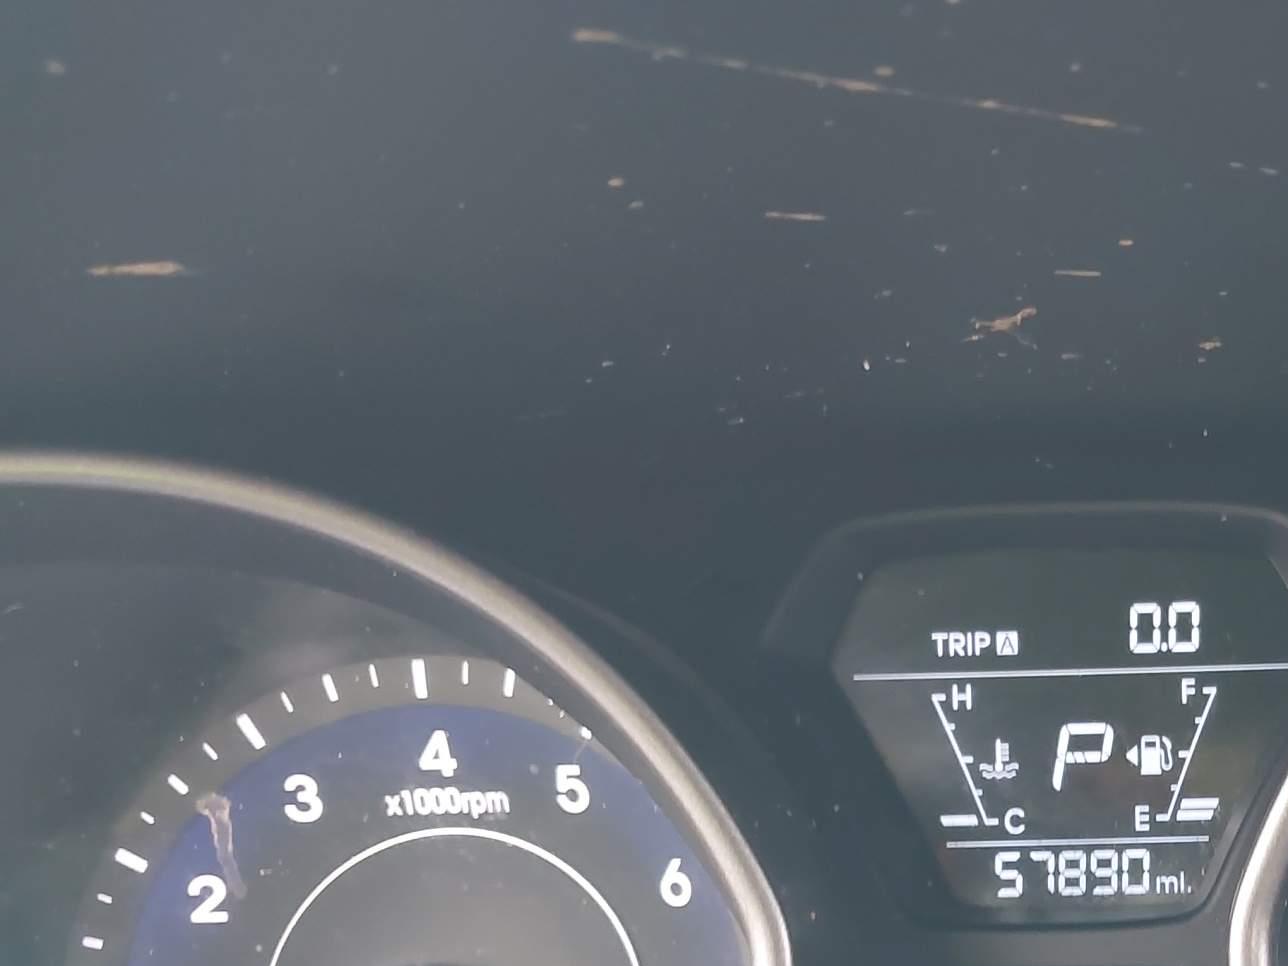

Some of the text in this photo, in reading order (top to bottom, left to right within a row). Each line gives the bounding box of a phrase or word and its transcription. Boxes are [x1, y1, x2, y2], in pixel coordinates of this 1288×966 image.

[931, 631, 991, 658] TRIP
[1129, 601, 1201, 654] 0.0
[951, 683, 972, 711] H
[1181, 677, 1196, 705] F
[418, 729, 458, 778] 4
[1052, 722, 1114, 792] P
[283, 774, 324, 823] 3
[384, 786, 511, 820] x1000rpm
[555, 764, 590, 814] 5
[1004, 807, 1026, 835] C
[1134, 804, 1150, 832] E
[659, 857, 692, 907] 6
[994, 848, 1151, 898] 57890
[187, 874, 229, 924] 2
